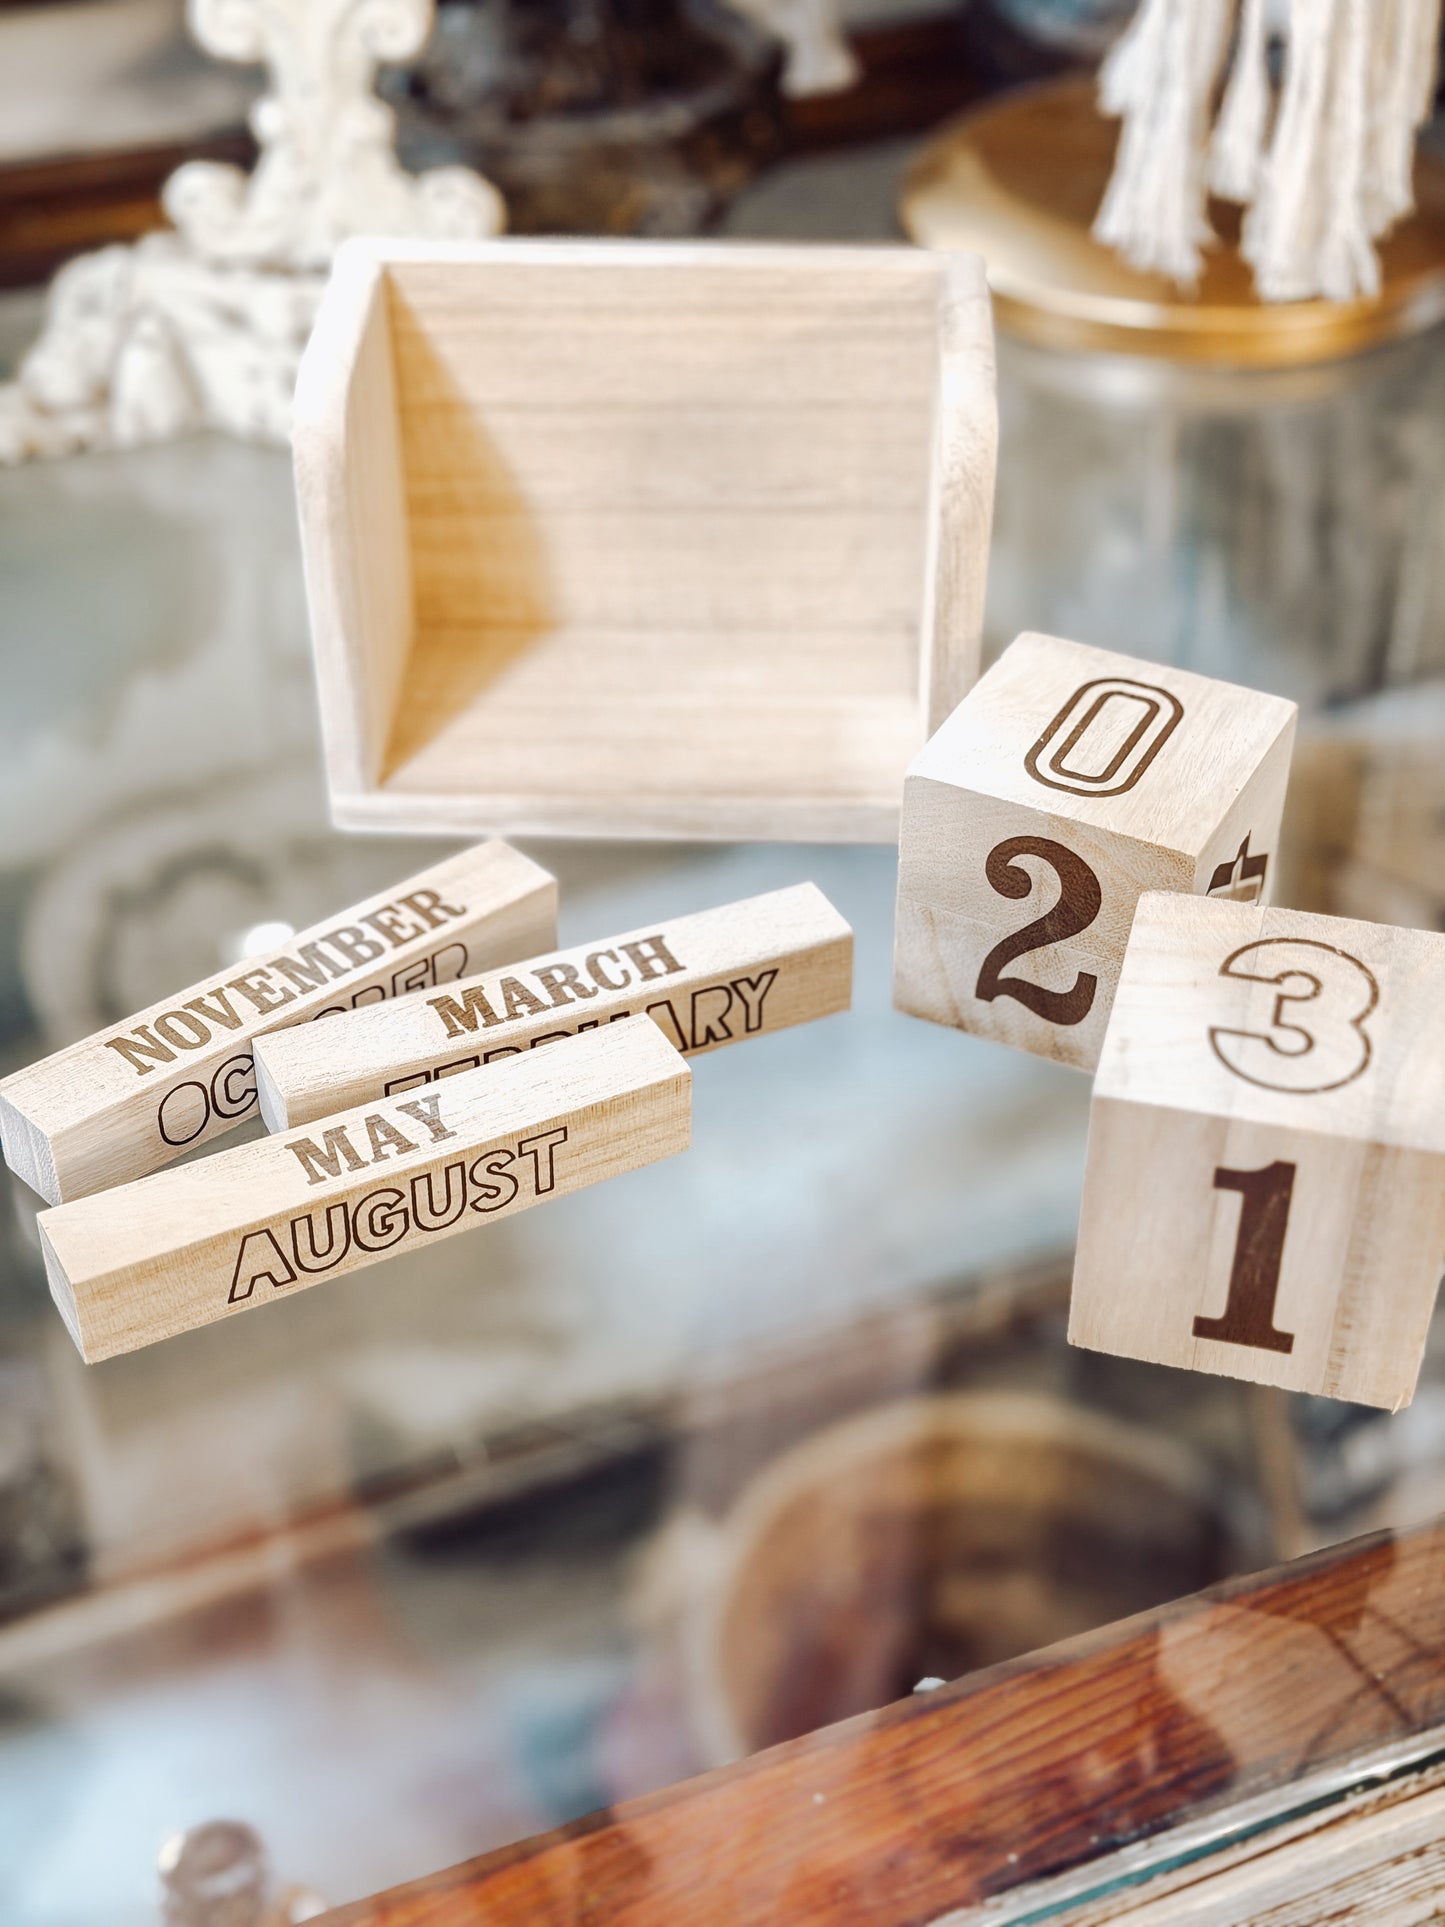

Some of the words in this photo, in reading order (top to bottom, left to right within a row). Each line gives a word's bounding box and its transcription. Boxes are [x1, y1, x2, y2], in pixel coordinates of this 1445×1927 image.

[1024, 677, 1184, 798] 0
[104, 887, 469, 1076] NOVEMBER
[426, 934, 687, 1039] MARCH
[975, 835, 1102, 1026] 2
[1208, 937, 1379, 1094] 3
[227, 1126, 568, 1304] AUGUST
[284, 1093, 458, 1186] MAY
[1192, 1160, 1297, 1354] 1
